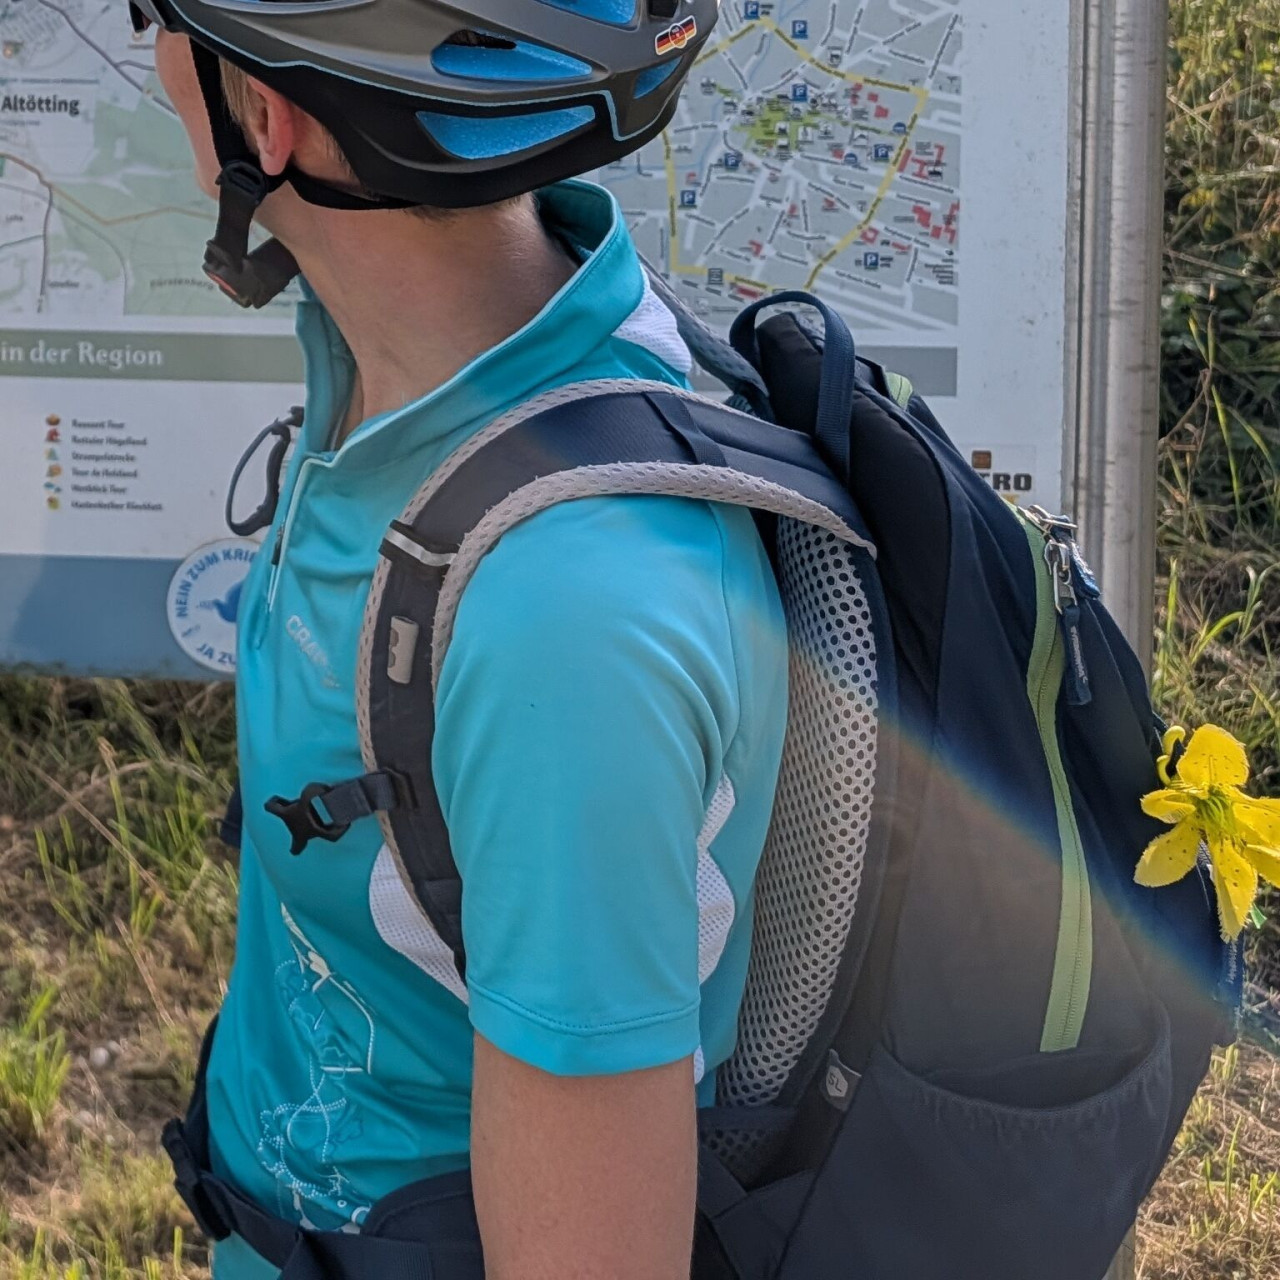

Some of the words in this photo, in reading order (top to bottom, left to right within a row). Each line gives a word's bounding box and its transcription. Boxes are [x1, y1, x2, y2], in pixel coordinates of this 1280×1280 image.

[2, 94, 79, 116] Altötting
[1, 341, 23, 361] in
[30, 340, 71, 363] der
[78, 341, 163, 370] Region
[176, 581, 192, 617] NEIN
[187, 552, 220, 580] ZUM
